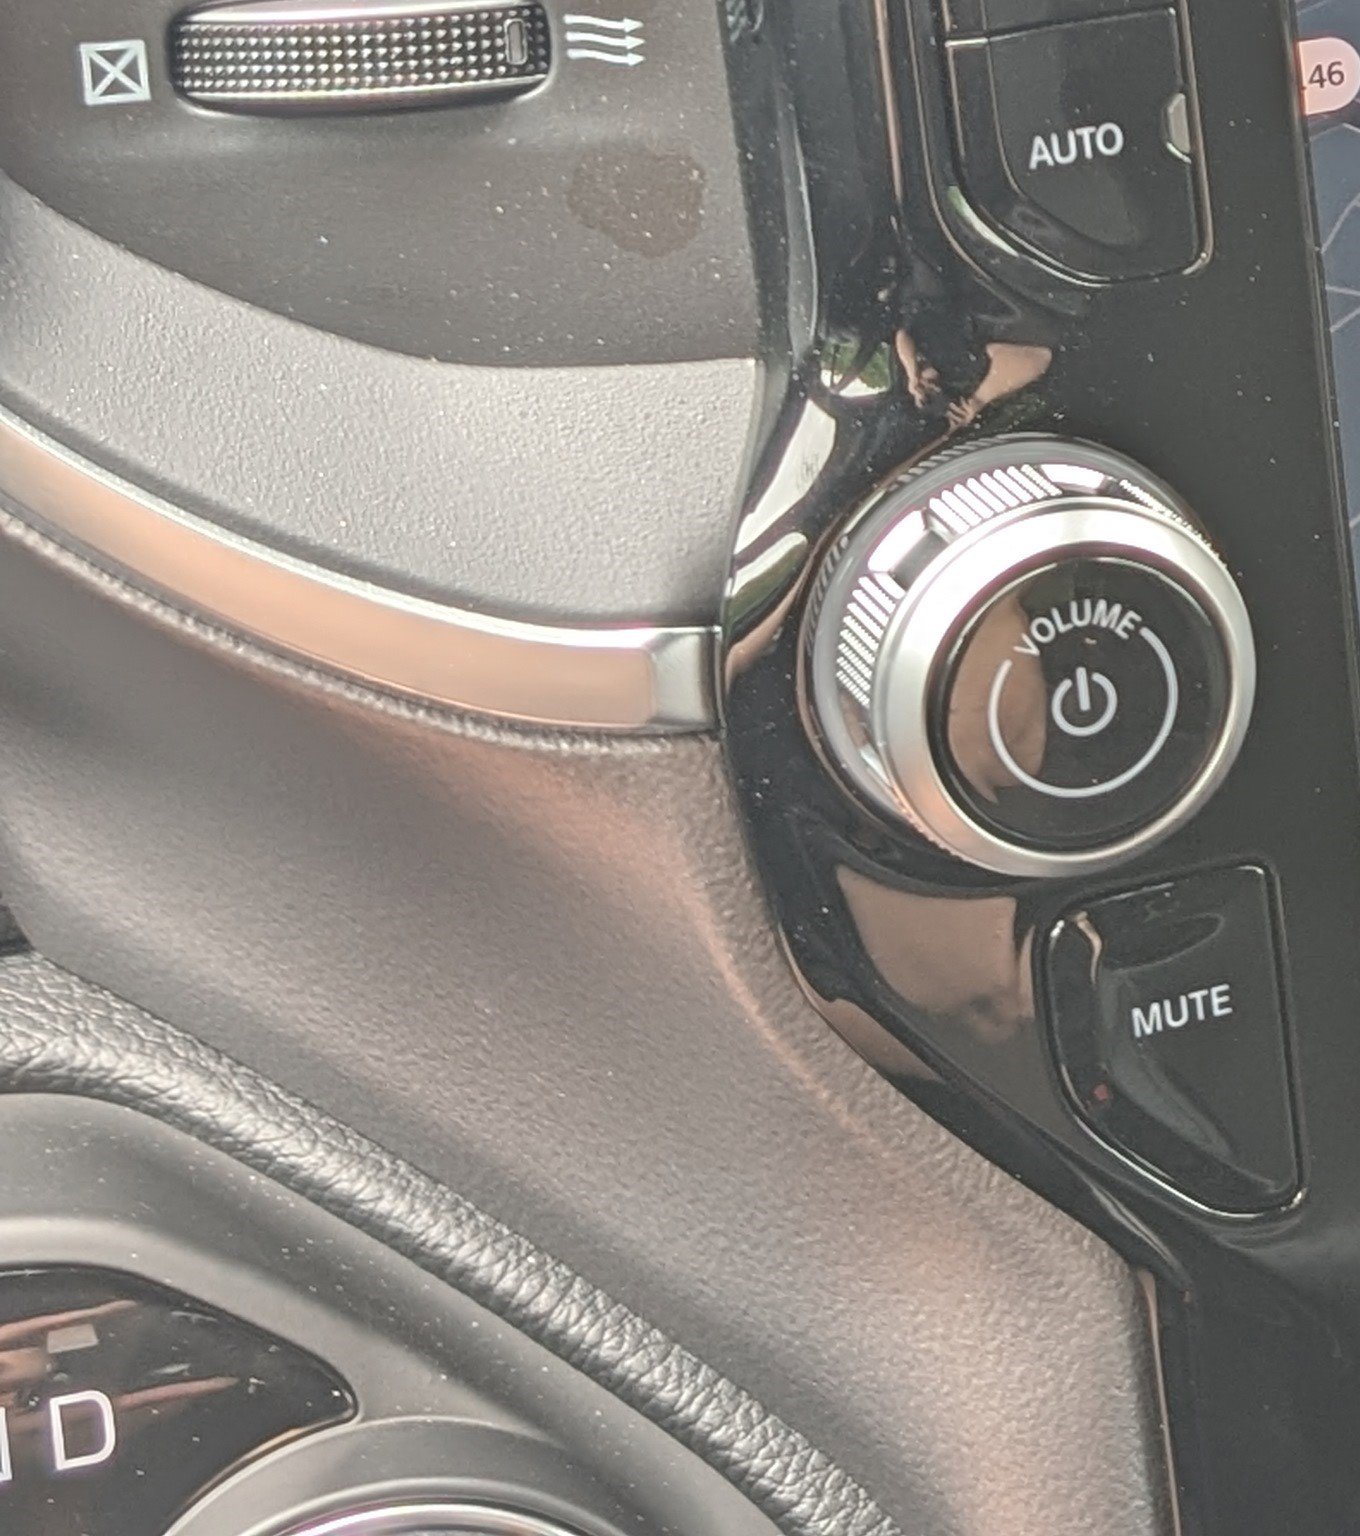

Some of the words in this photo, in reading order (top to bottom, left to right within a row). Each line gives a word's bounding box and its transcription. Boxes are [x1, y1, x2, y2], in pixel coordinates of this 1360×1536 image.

[1300, 61, 1345, 89] 46
[1029, 122, 1124, 170] AUTO
[1014, 598, 1141, 659] VOLUME
[1131, 984, 1233, 1038] MUTE
